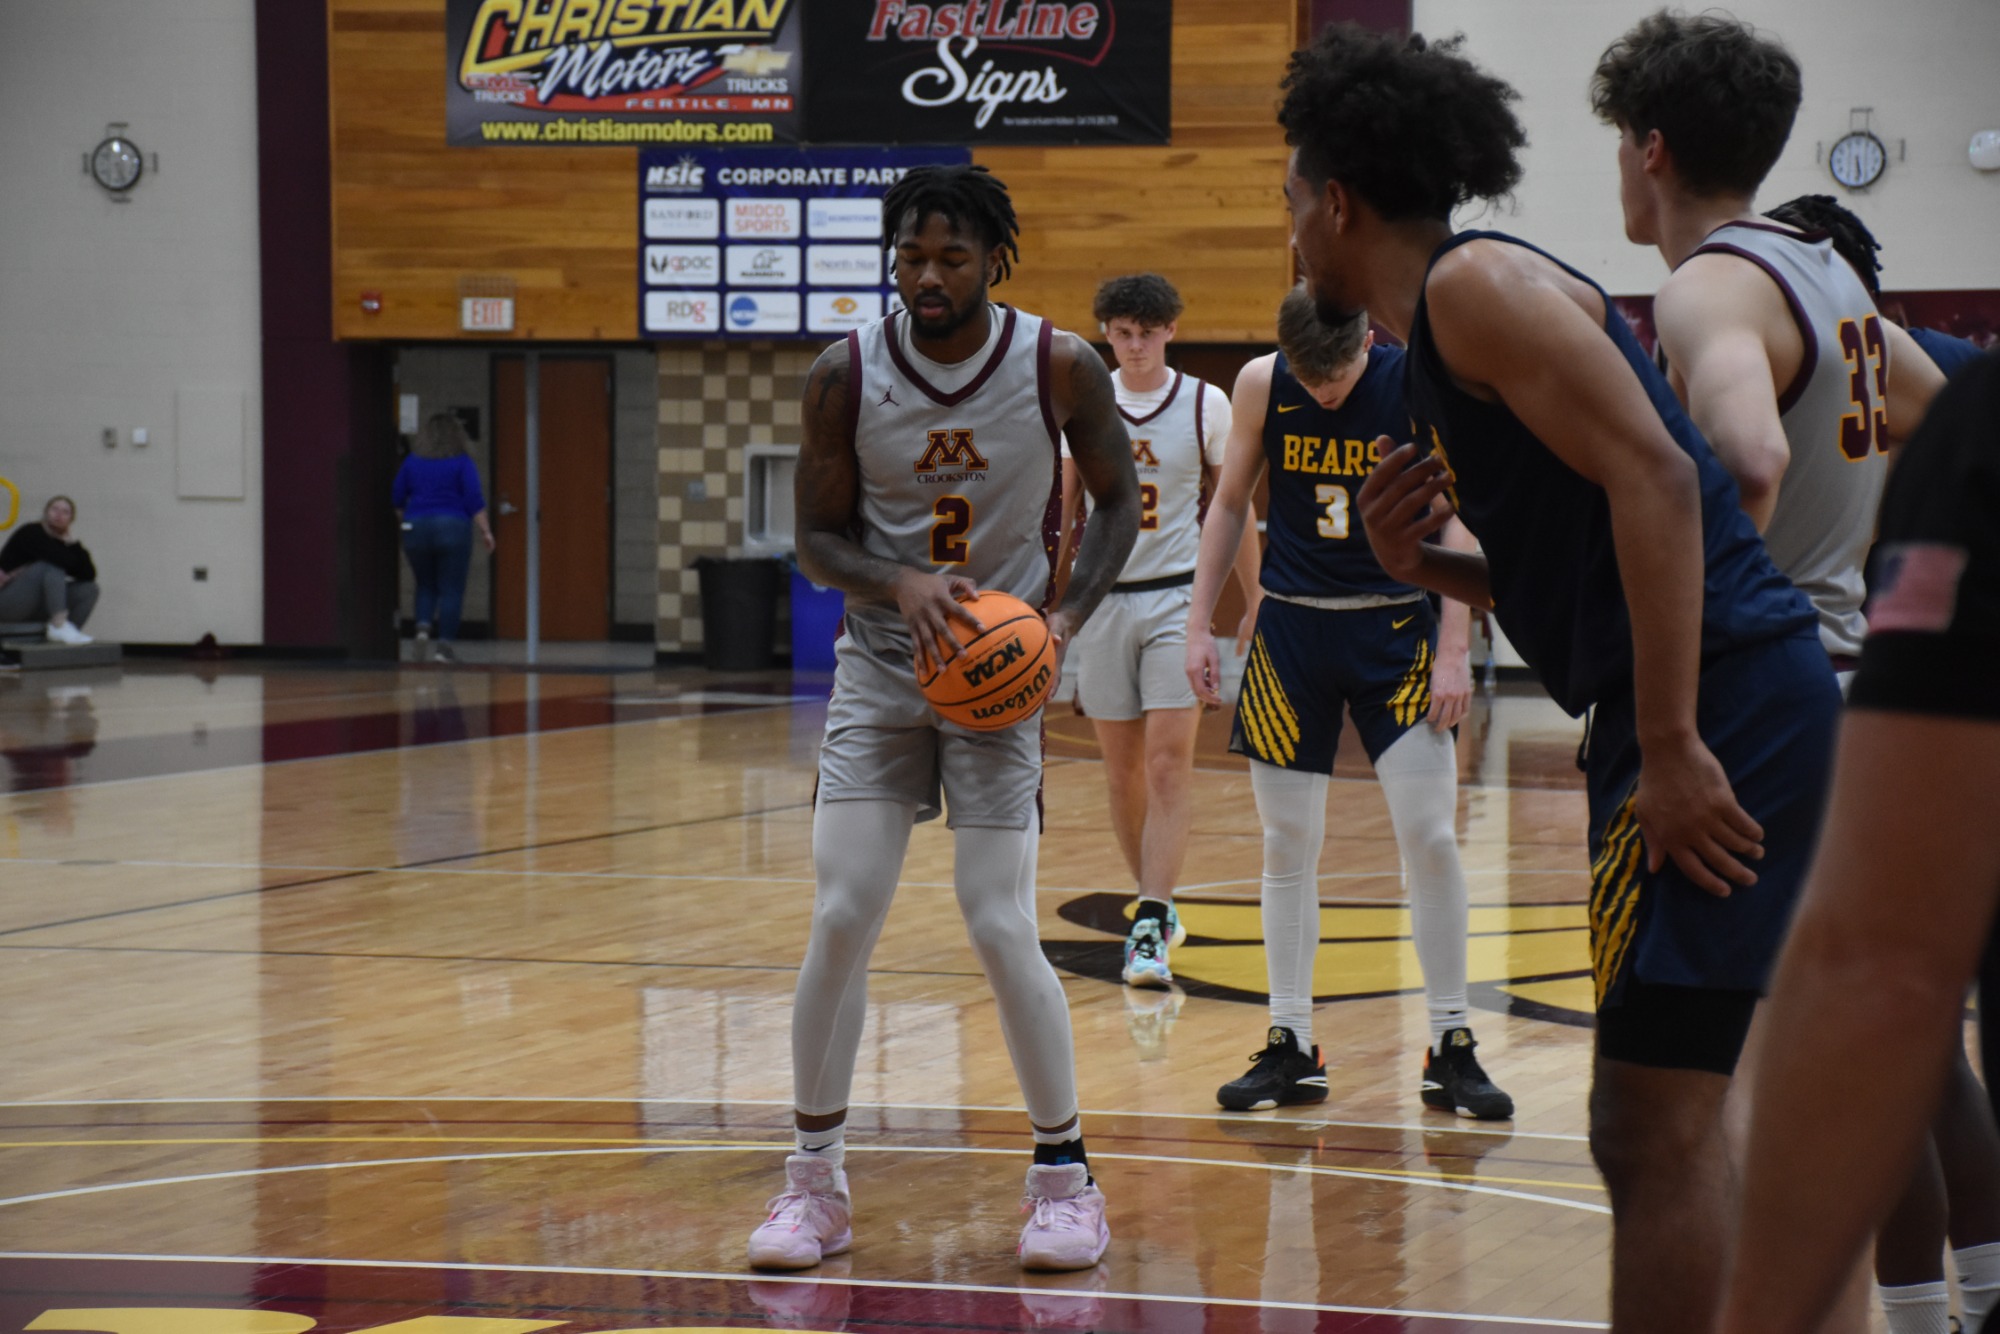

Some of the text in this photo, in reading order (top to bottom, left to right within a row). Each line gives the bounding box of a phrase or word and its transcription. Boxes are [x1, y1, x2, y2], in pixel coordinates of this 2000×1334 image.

[866, 0, 1100, 40] FastLine
[459, 0, 790, 76] CHRISTIAN
[538, 41, 714, 102] Motors
[726, 78, 788, 93] TRUCKS
[902, 31, 1068, 129] Signs
[474, 90, 527, 103] TRUCKS
[752, 98, 790, 110] MN
[481, 118, 773, 142] www.christianmotors.com
[717, 168, 847, 185] CORPORATE
[735, 204, 785, 218] MIDCO
[735, 219, 790, 232] SPORTS
[472, 301, 504, 326] EXIT
[1837, 312, 1890, 463] 33
[917, 472, 987, 485] CROOKSTON
[1315, 483, 1350, 539] 3
[930, 494, 972, 566] 2
[962, 636, 1025, 688] NCAA
[970, 663, 1052, 720] Wilson
